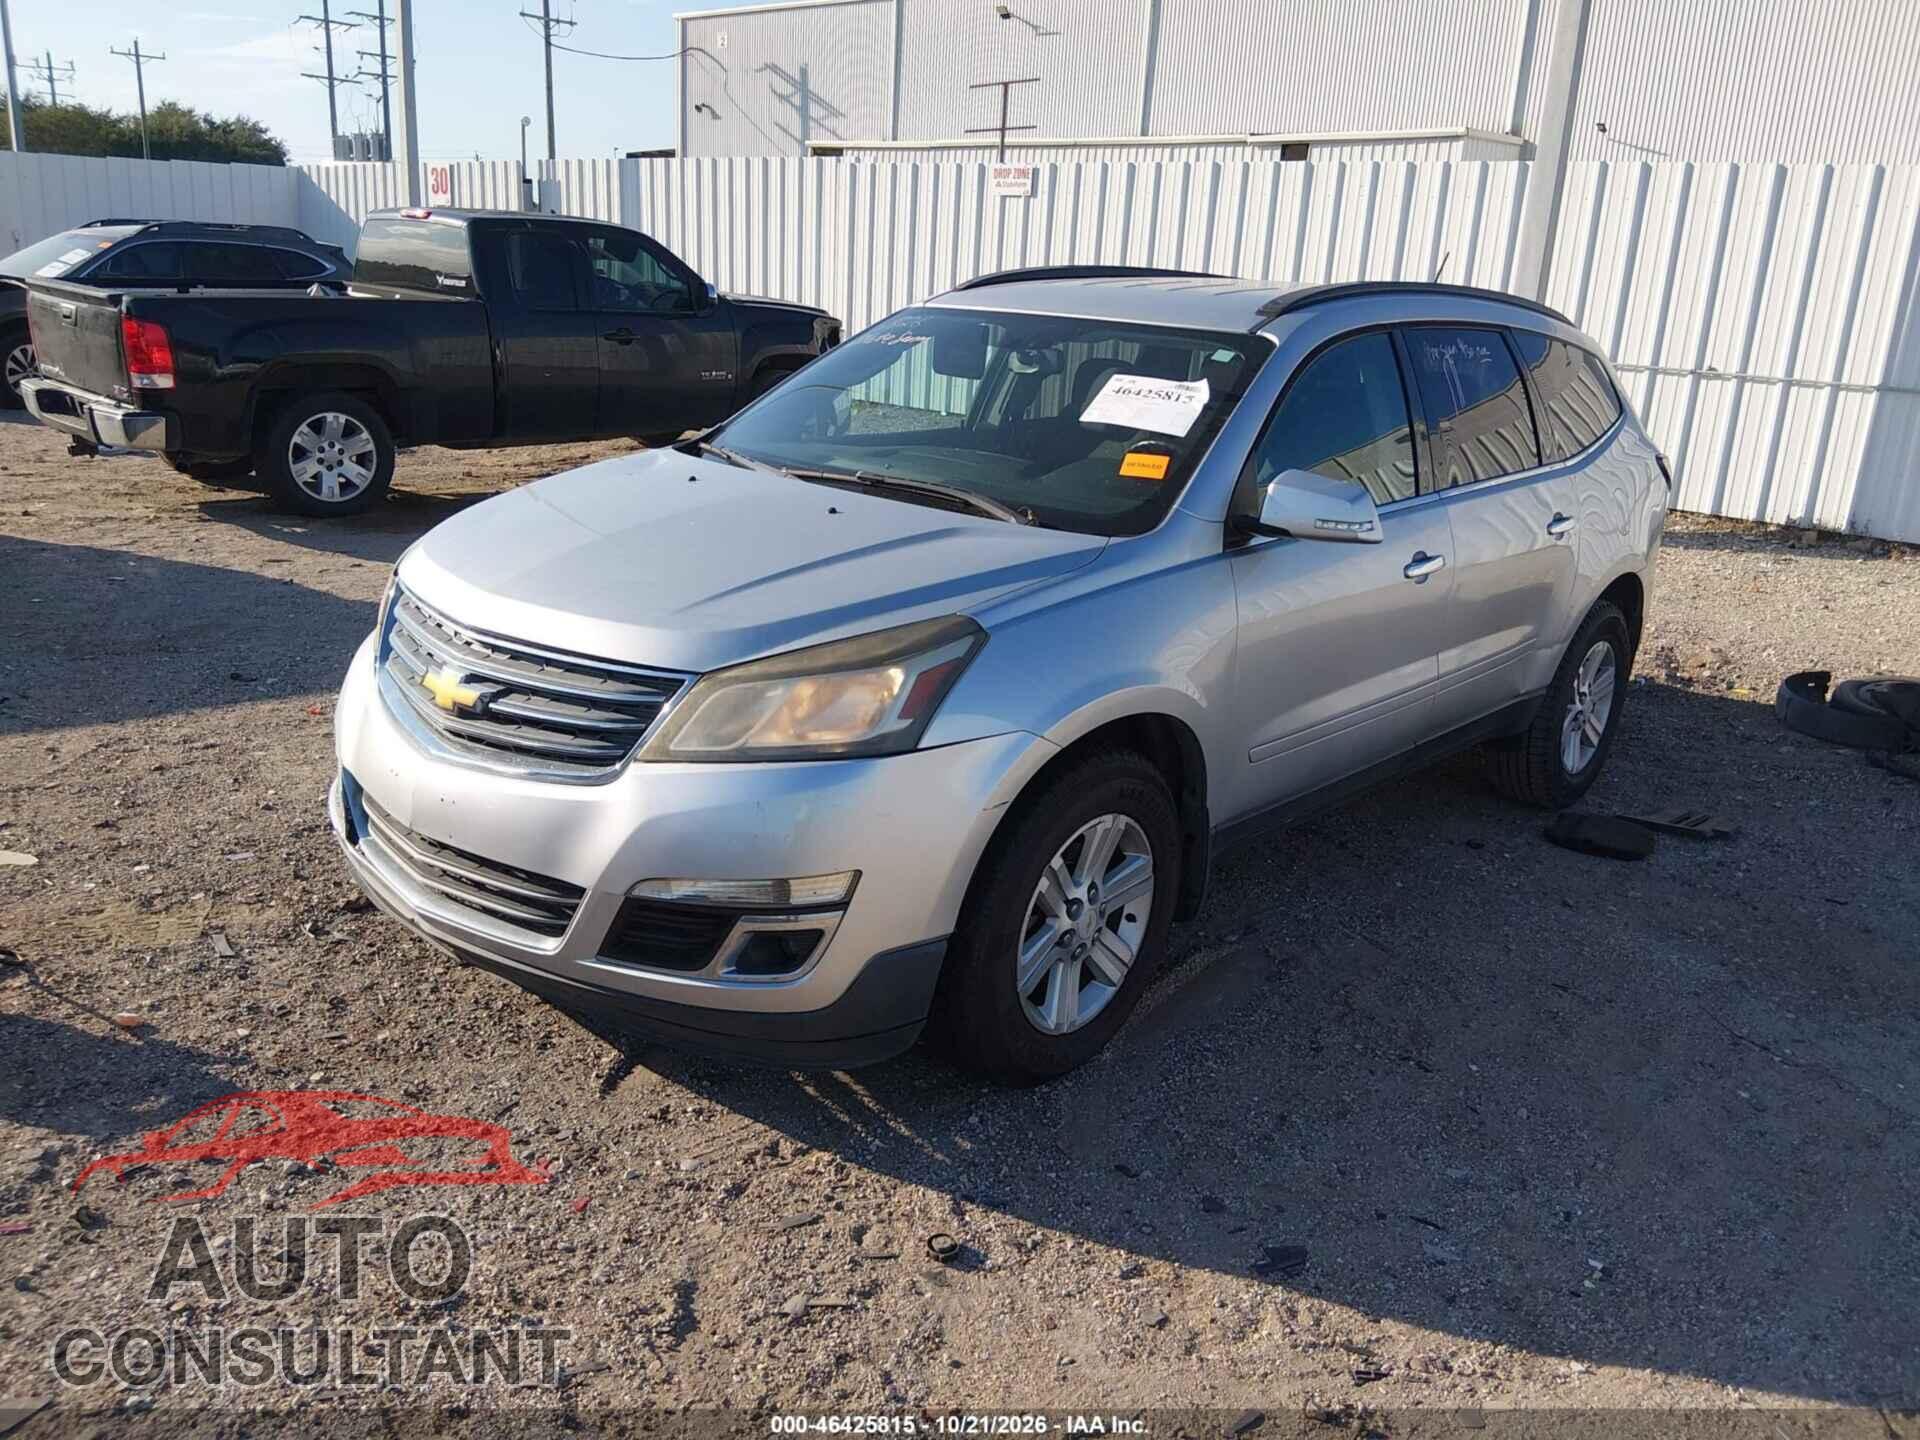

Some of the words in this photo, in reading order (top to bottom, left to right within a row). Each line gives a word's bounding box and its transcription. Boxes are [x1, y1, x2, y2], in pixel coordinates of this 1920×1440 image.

[431, 167, 449, 194] 30
[993, 167, 1012, 179] DROP
[1013, 167, 1030, 179] ZONE
